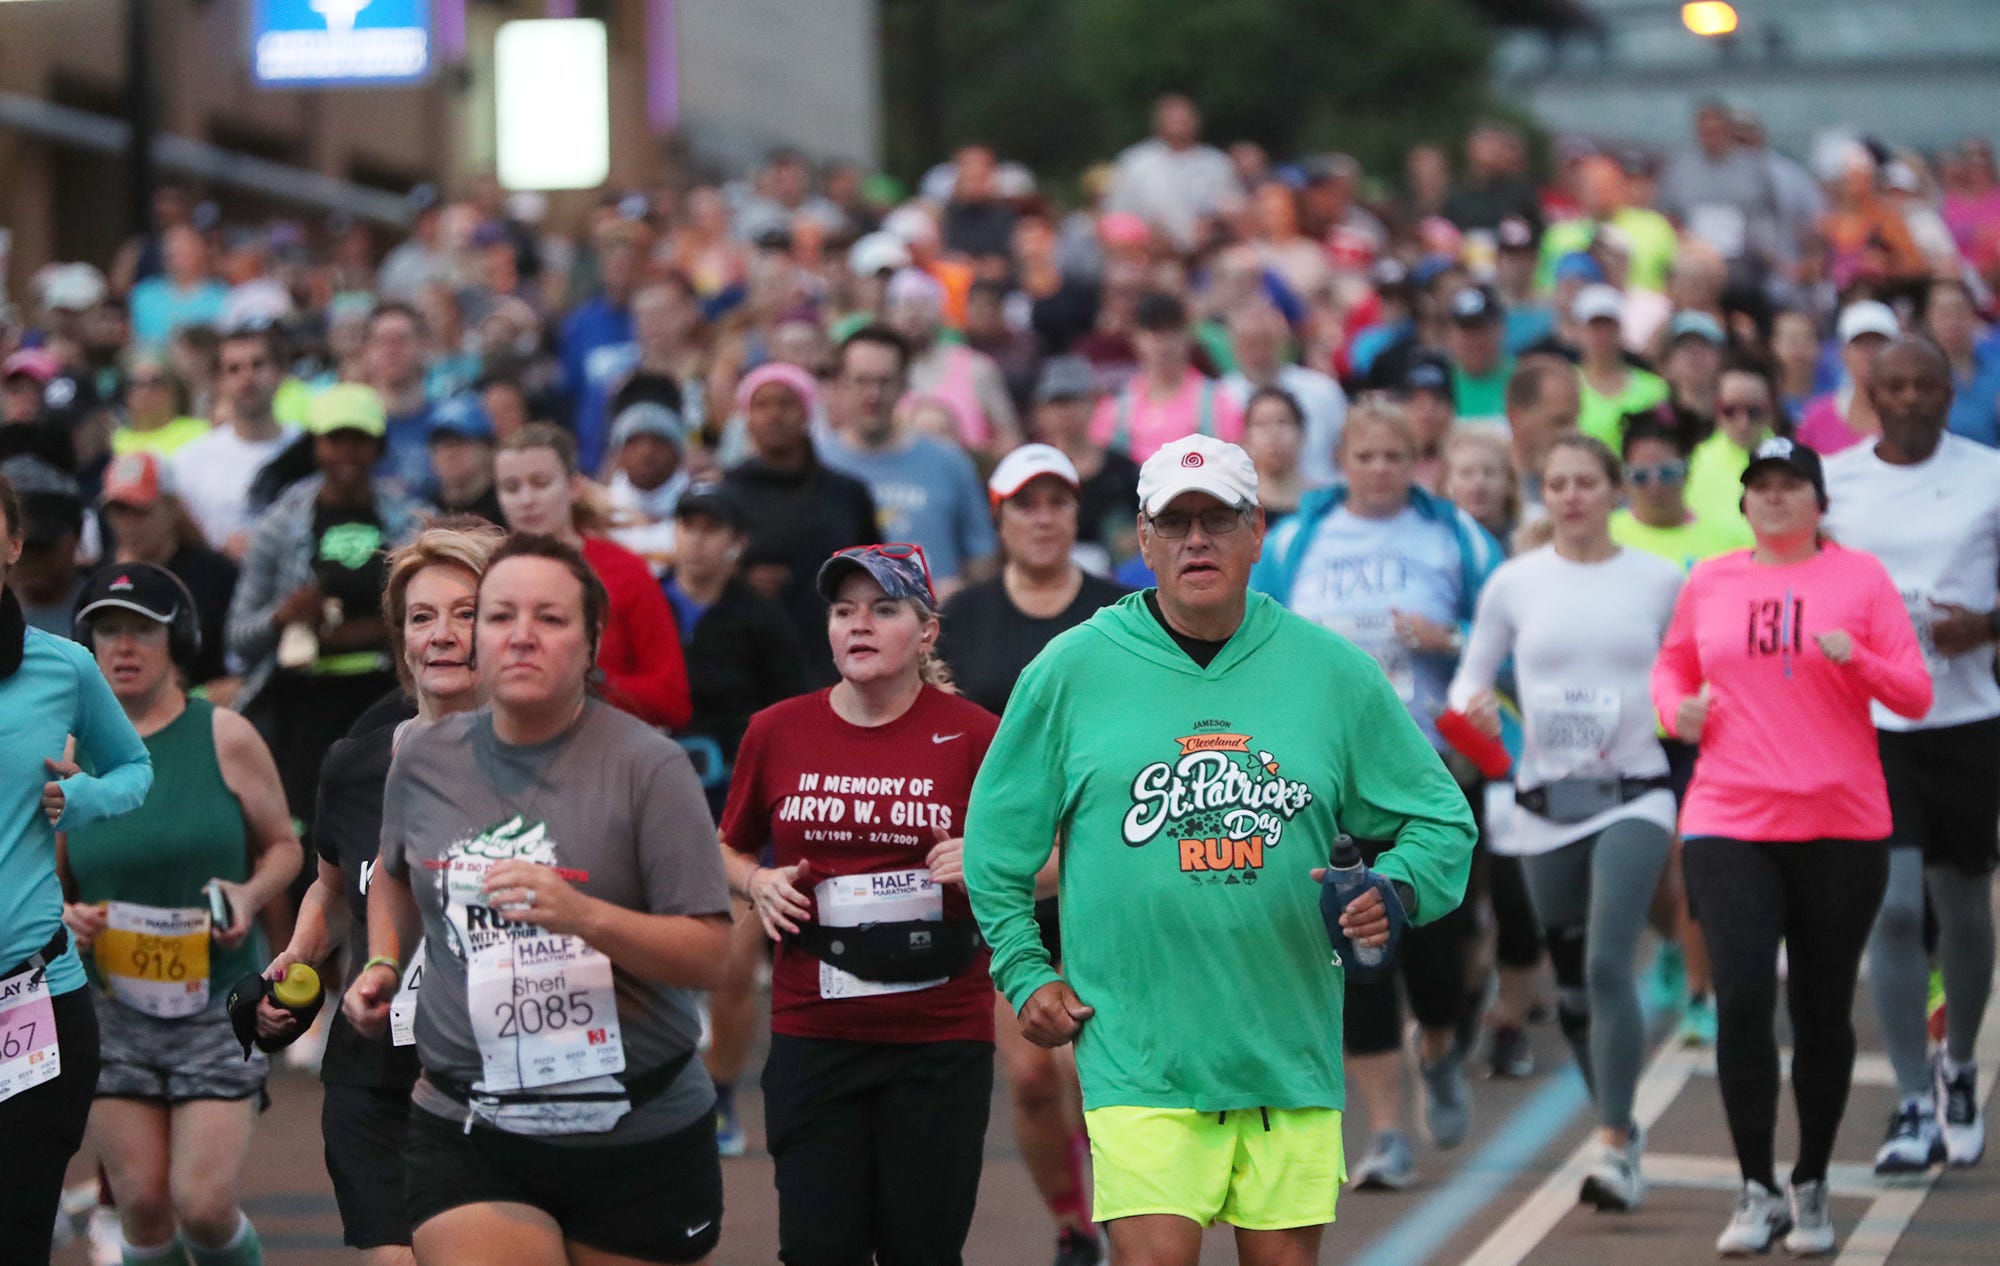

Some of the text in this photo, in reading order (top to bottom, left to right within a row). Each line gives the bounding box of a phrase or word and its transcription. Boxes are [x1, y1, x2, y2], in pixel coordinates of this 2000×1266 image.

[1192, 719, 1232, 730] JAMESON
[1186, 736, 1242, 751] Cleveland
[798, 773, 934, 797] IN MEMORY OF
[779, 796, 953, 830] JARYD W. GILTS
[804, 829, 853, 842] 8/8/1989
[868, 831, 919, 846] 2/8/2009
[1222, 808, 1283, 848] Day
[1178, 836, 1263, 872] RUN
[872, 873, 915, 889] HALF
[873, 887, 918, 896] MARATHON
[469, 927, 538, 943] WITH YOUR
[519, 938, 574, 959] HALF
[521, 952, 576, 966] MARATHON
[131, 950, 187, 981] 916
[514, 971, 566, 997] Sheri
[495, 991, 594, 1039] 2085
[0, 1021, 36, 1058] 67
